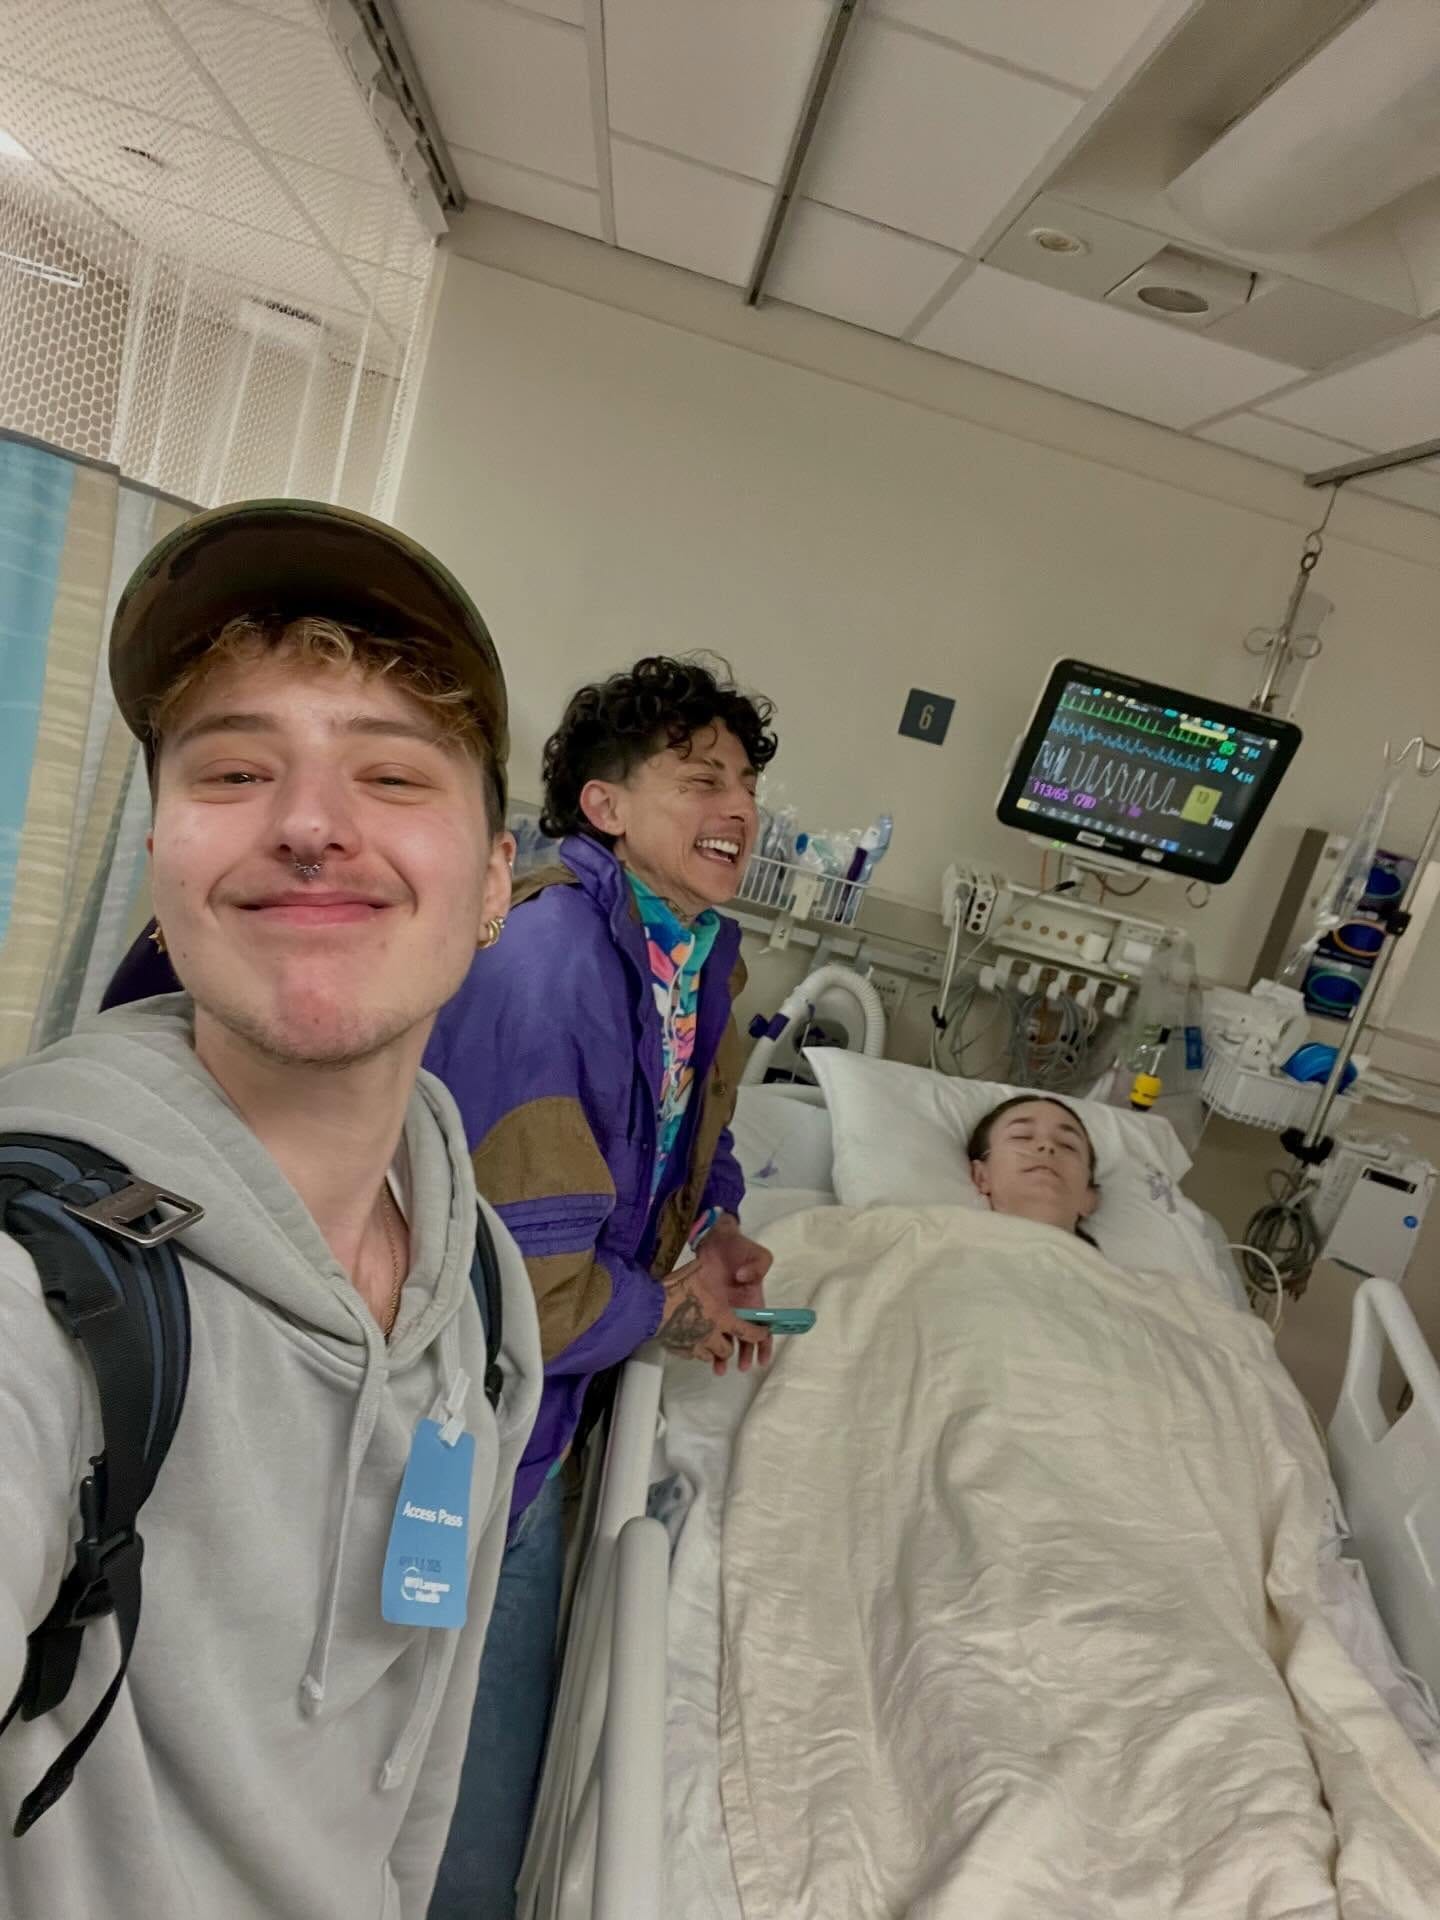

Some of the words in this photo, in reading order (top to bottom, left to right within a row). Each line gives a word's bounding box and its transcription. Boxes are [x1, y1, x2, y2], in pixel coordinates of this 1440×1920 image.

[918, 704, 936, 730] 6
[1033, 780, 1069, 801] 113/65
[402, 1501, 436, 1522] Access
[438, 1508, 463, 1528] Pass
